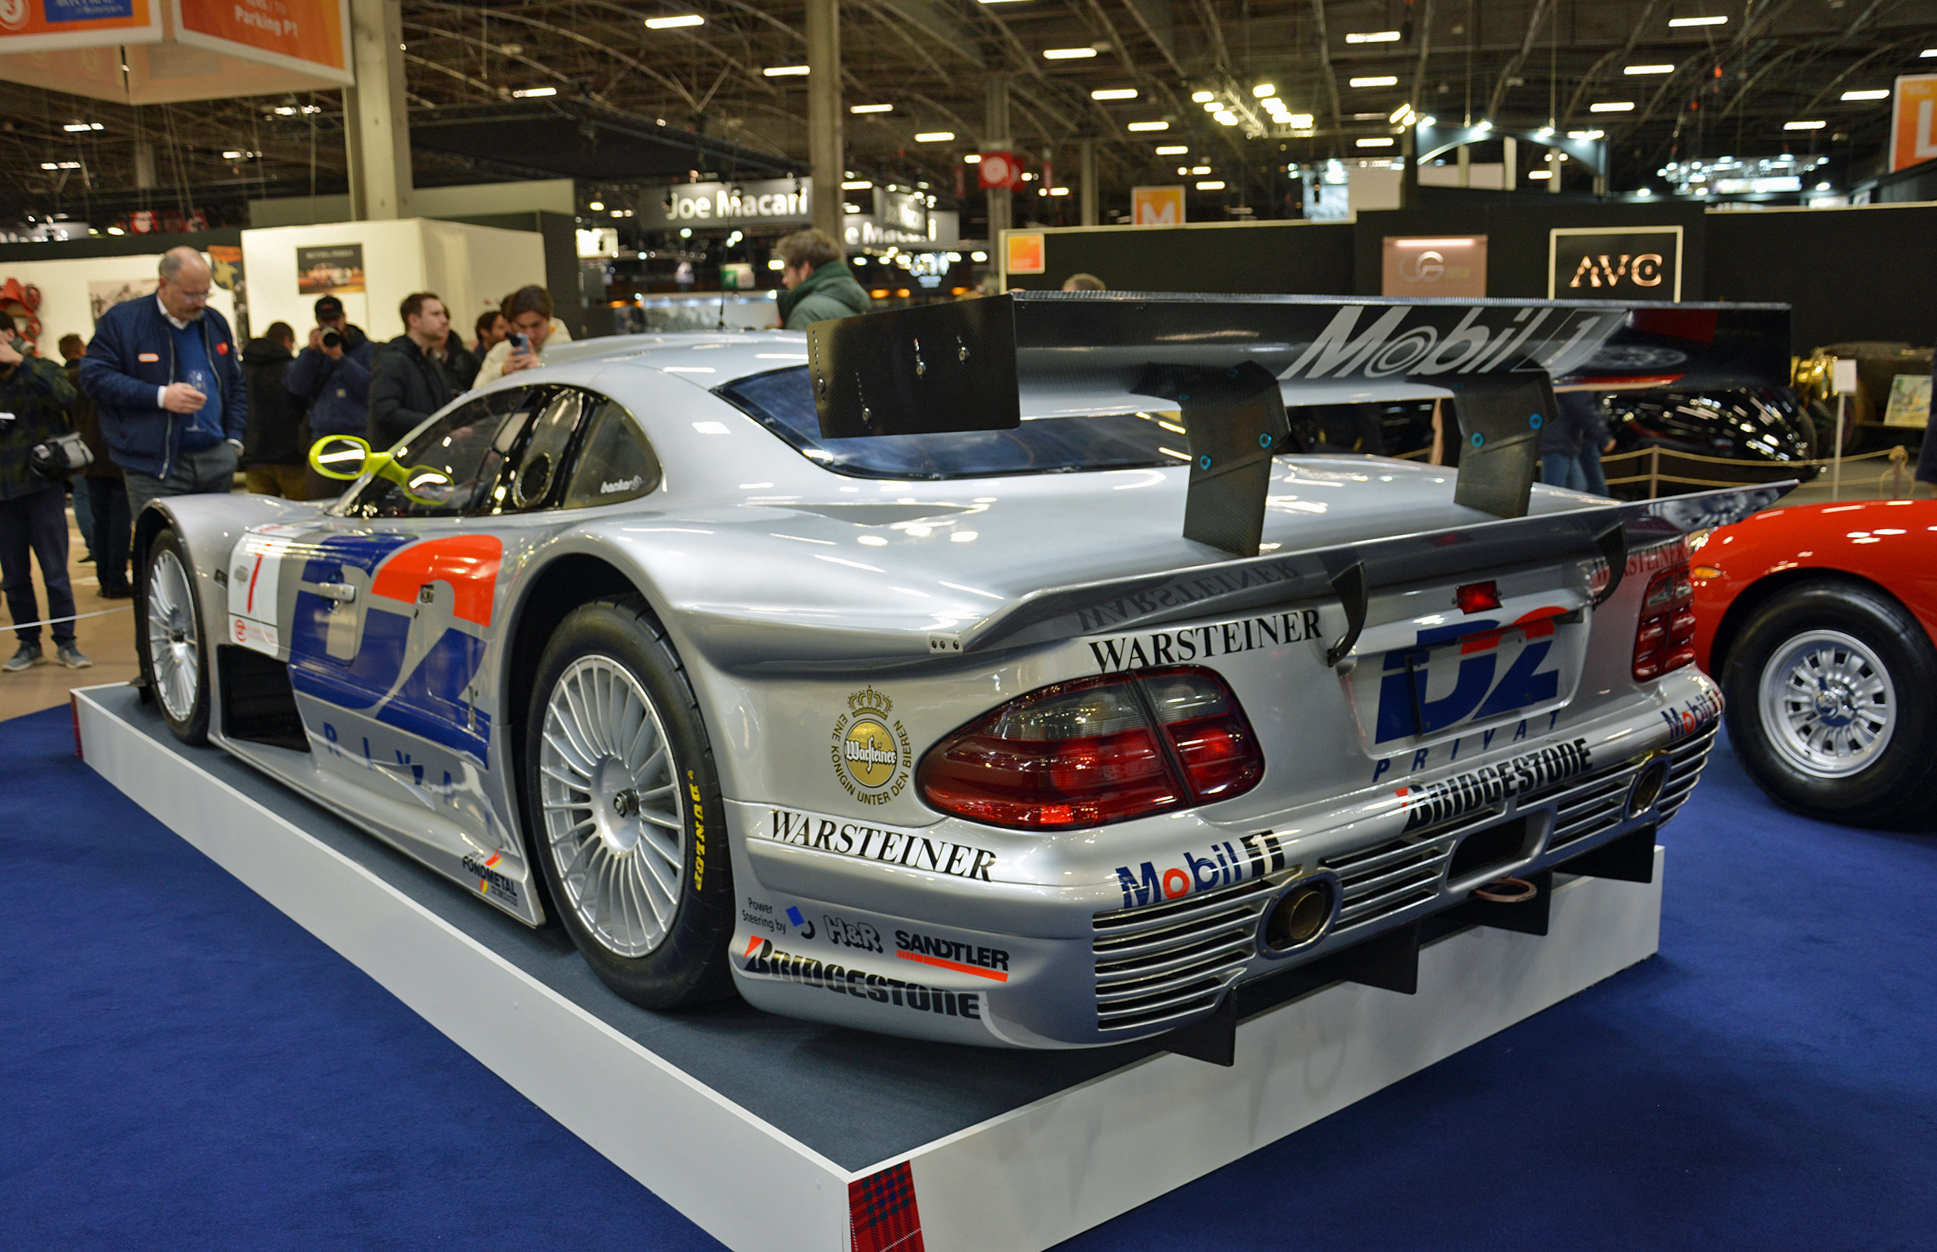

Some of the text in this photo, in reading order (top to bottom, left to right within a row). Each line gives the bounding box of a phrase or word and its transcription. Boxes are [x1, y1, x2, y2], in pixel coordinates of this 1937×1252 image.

[234, 4, 282, 37] Parking
[665, 186, 808, 220] Joe Macari
[1141, 200, 1176, 227] M
[1279, 306, 1620, 379] Mobil 1
[289, 533, 503, 772] D2
[1088, 609, 1322, 674] WARSTEINER
[1375, 606, 1570, 745] D2
[1371, 711, 1562, 784] PRIVAT
[1661, 695, 1713, 739] Mobil
[831, 712, 912, 806] EINE KÖNIGIN UNTER DEN BIEREN
[1395, 737, 1594, 834] BRIDGESTONE
[688, 782, 706, 891] DUNLOP
[771, 808, 997, 882] WARSTEINER
[1114, 831, 1279, 909] Mobil 1
[462, 855, 518, 897] FONDMETAL
[747, 896, 773, 915] Power
[741, 909, 787, 935] Steering by
[823, 915, 884, 954] H&R
[894, 929, 1010, 972] SANDTLER
[743, 935, 981, 1020] BRIDGESTONE
